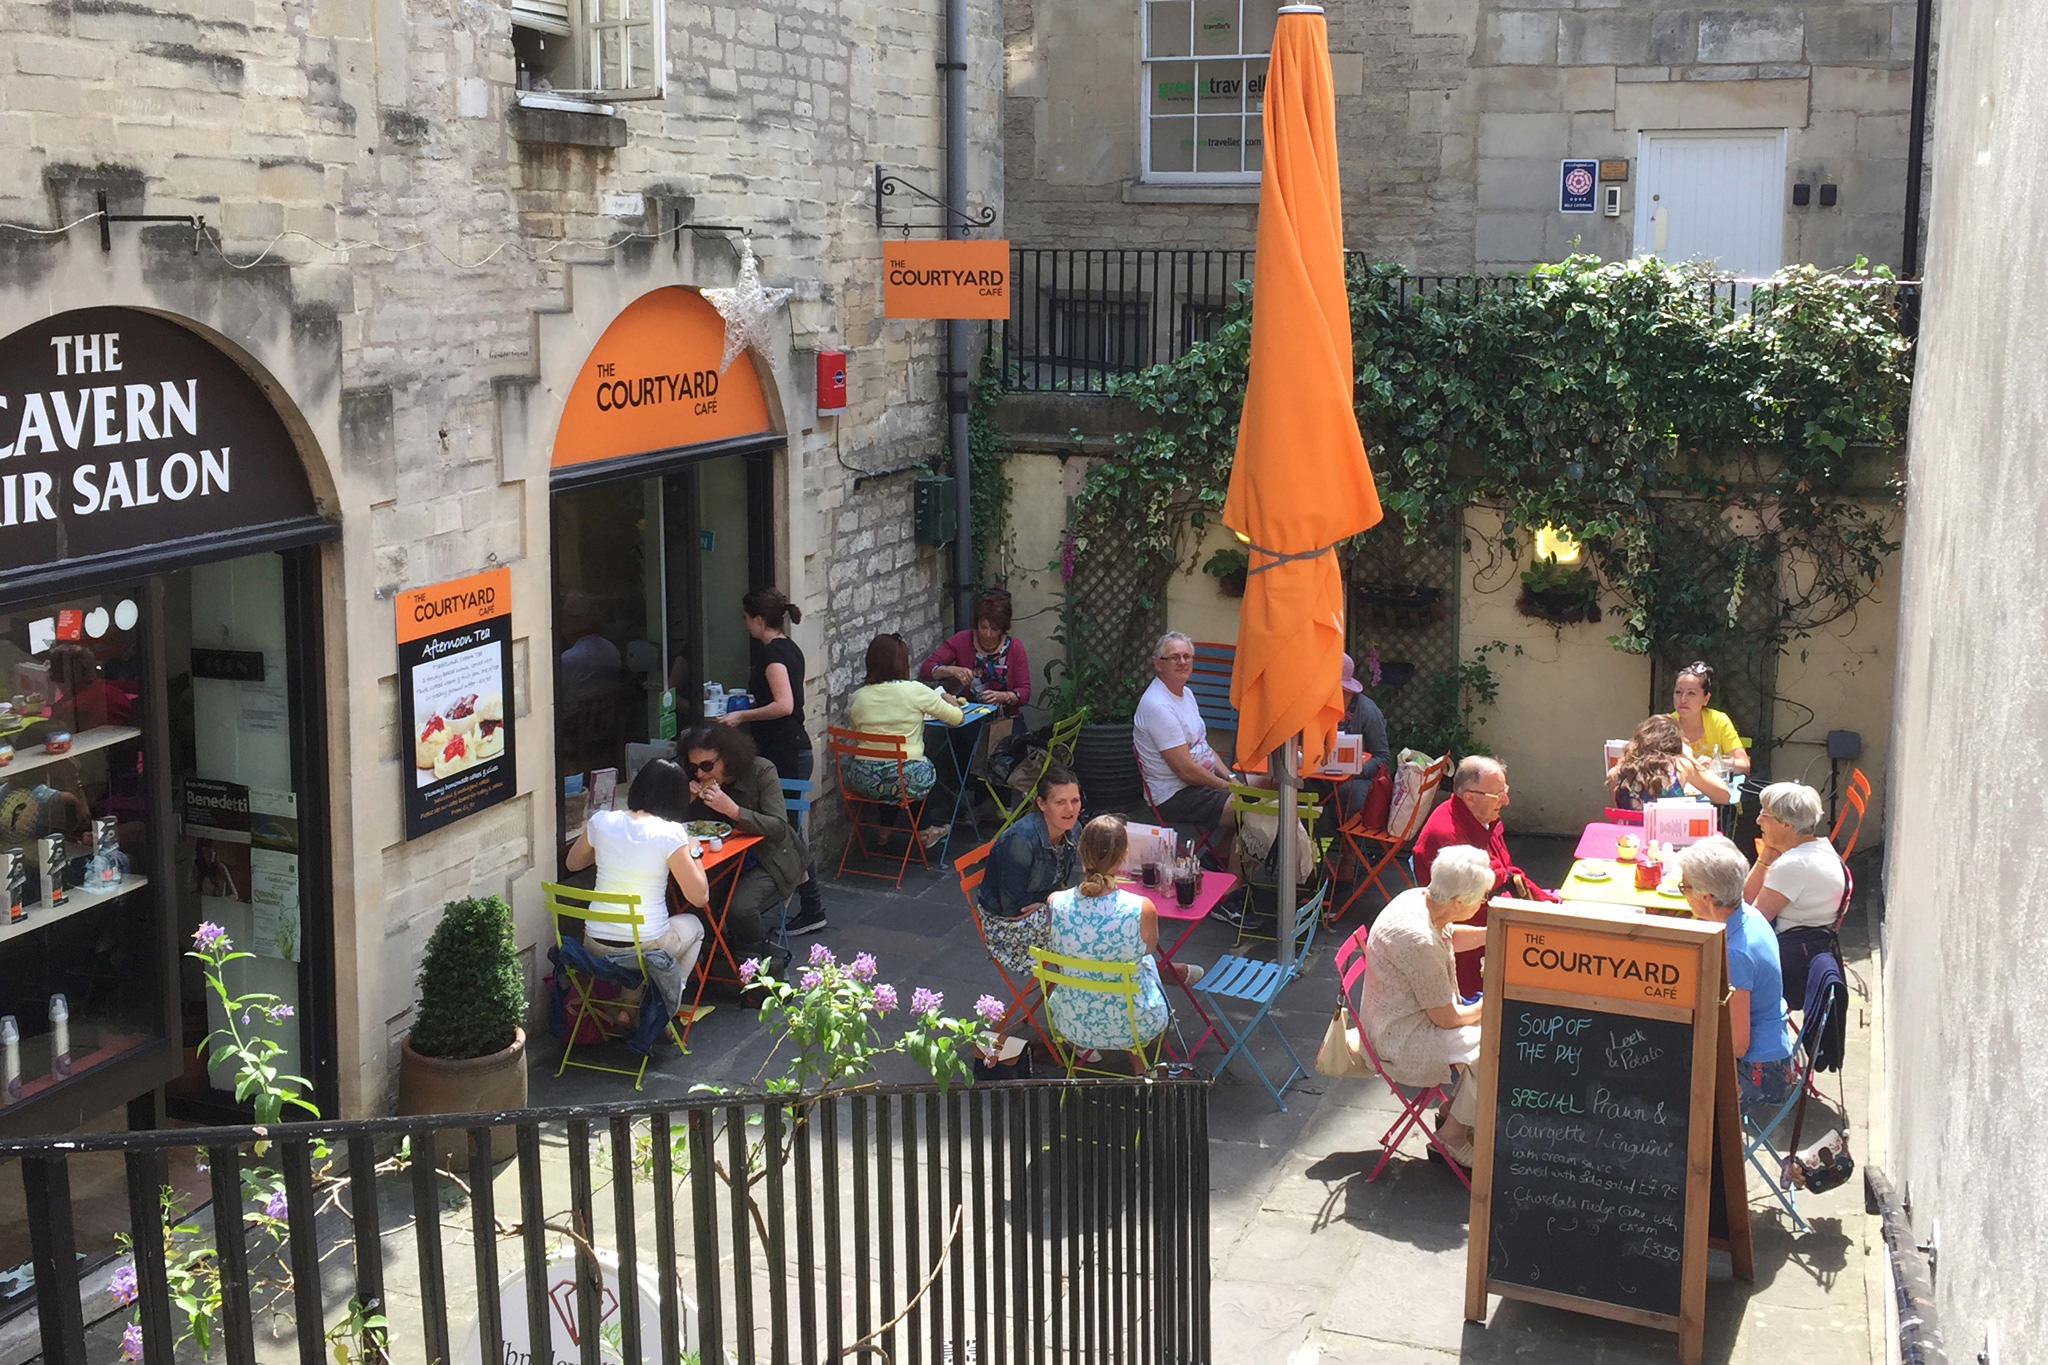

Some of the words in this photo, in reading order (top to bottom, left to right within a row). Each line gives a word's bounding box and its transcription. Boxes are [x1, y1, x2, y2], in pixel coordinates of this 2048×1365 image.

[890, 260, 905, 268] THE
[890, 270, 1004, 286] COURTYARD
[979, 287, 1002, 296] CAFÉ
[51, 333, 122, 376] THE
[597, 363, 615, 378] THE
[596, 370, 718, 412] COURTYARD
[694, 397, 718, 416] CAFÉ
[0, 471, 57, 527] IR
[72, 447, 231, 515] SALON
[414, 592, 426, 602] THE
[414, 587, 495, 622] COURTYARD
[422, 634, 473, 659] Afternoon
[474, 628, 490, 642] Tea
[187, 790, 248, 812] Benedetti
[1524, 933, 1544, 945] THE
[1522, 947, 1680, 985] COURTYARD
[1644, 986, 1677, 1000] CAFÉ
[1566, 1018, 1592, 1036] OF
[1610, 1028, 1646, 1050] Leek
[1516, 1042, 1546, 1064] THE
[1620, 1048, 1664, 1070] Potato
[1511, 1088, 1584, 1114] SPECIAL
[1593, 1088, 1648, 1122] Prawn
[1654, 1101, 1667, 1125] &
[1506, 1113, 1588, 1150] Courgette
